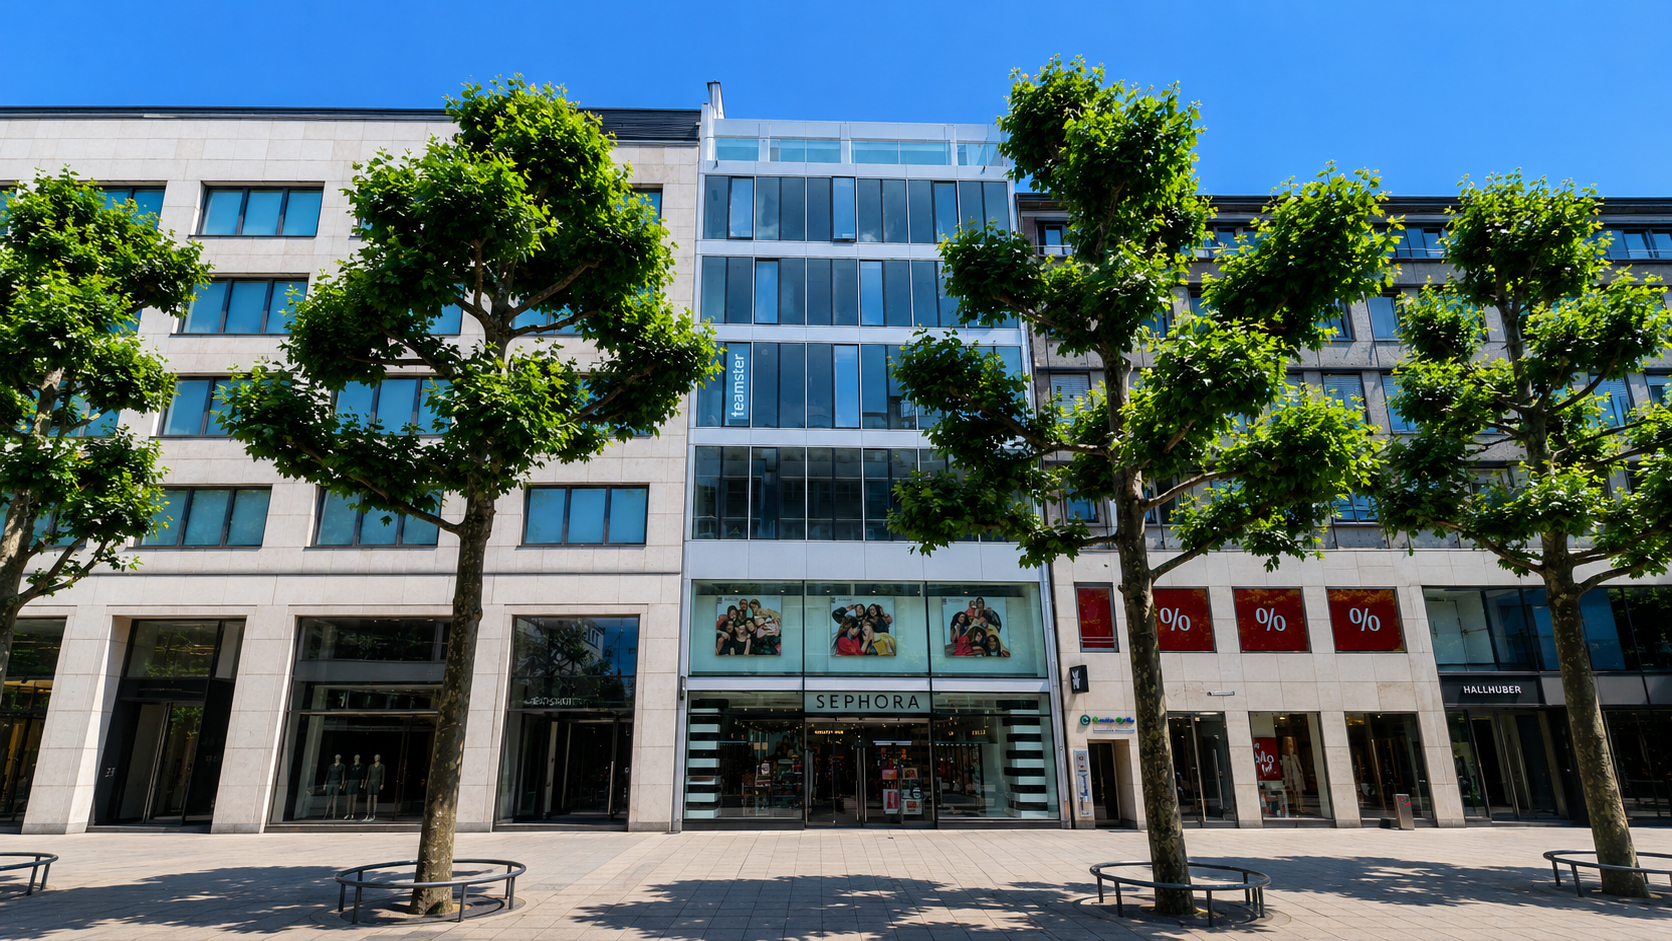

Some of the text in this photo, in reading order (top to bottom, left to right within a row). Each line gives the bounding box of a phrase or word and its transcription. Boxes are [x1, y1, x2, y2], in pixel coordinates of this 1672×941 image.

[731, 353, 744, 417] teamster
[1159, 607, 1191, 632] %
[1255, 607, 1287, 632] %
[1349, 607, 1381, 632] %
[816, 694, 920, 709] SEPHORA
[1463, 685, 1522, 694] HALLHUBER
